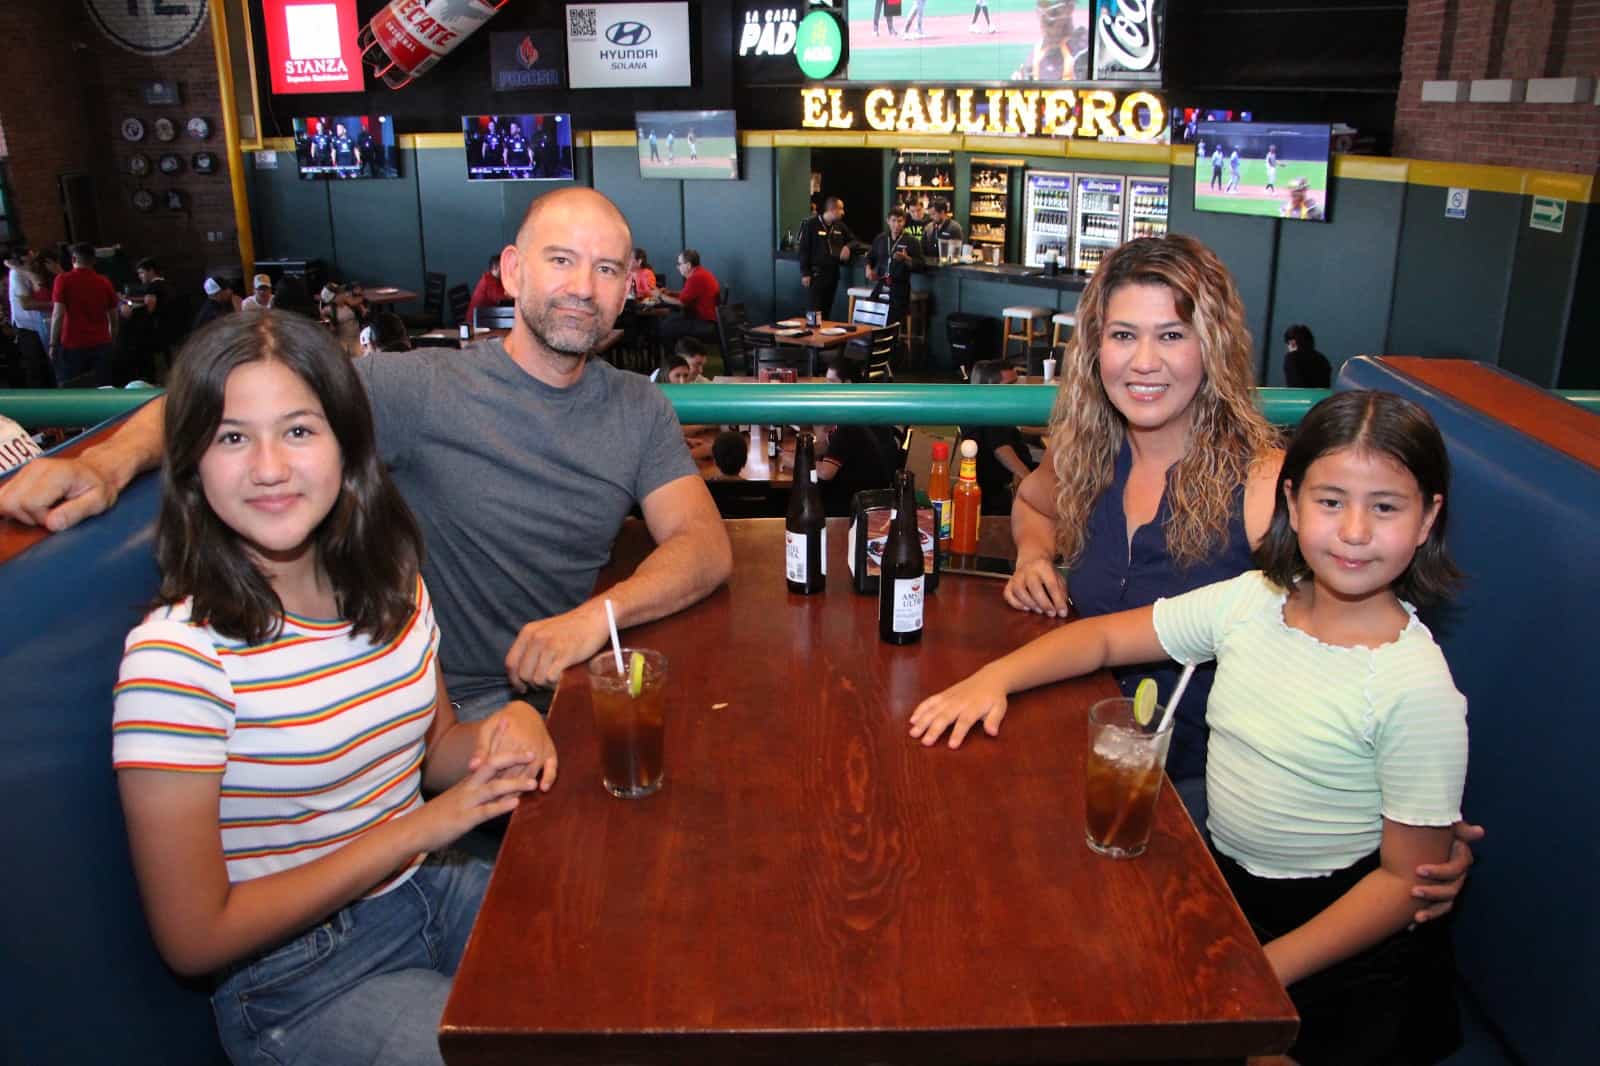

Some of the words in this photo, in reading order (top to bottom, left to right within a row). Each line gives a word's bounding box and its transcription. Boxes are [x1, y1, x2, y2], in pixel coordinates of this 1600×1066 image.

[745, 11, 759, 24] LA
[765, 8, 797, 23] CASA
[600, 48, 658, 60] HYUNDAI
[285, 59, 348, 74] STANZA
[611, 62, 648, 70] SOLANA
[800, 88, 853, 130] EL
[864, 88, 1165, 140] GALLINERO
